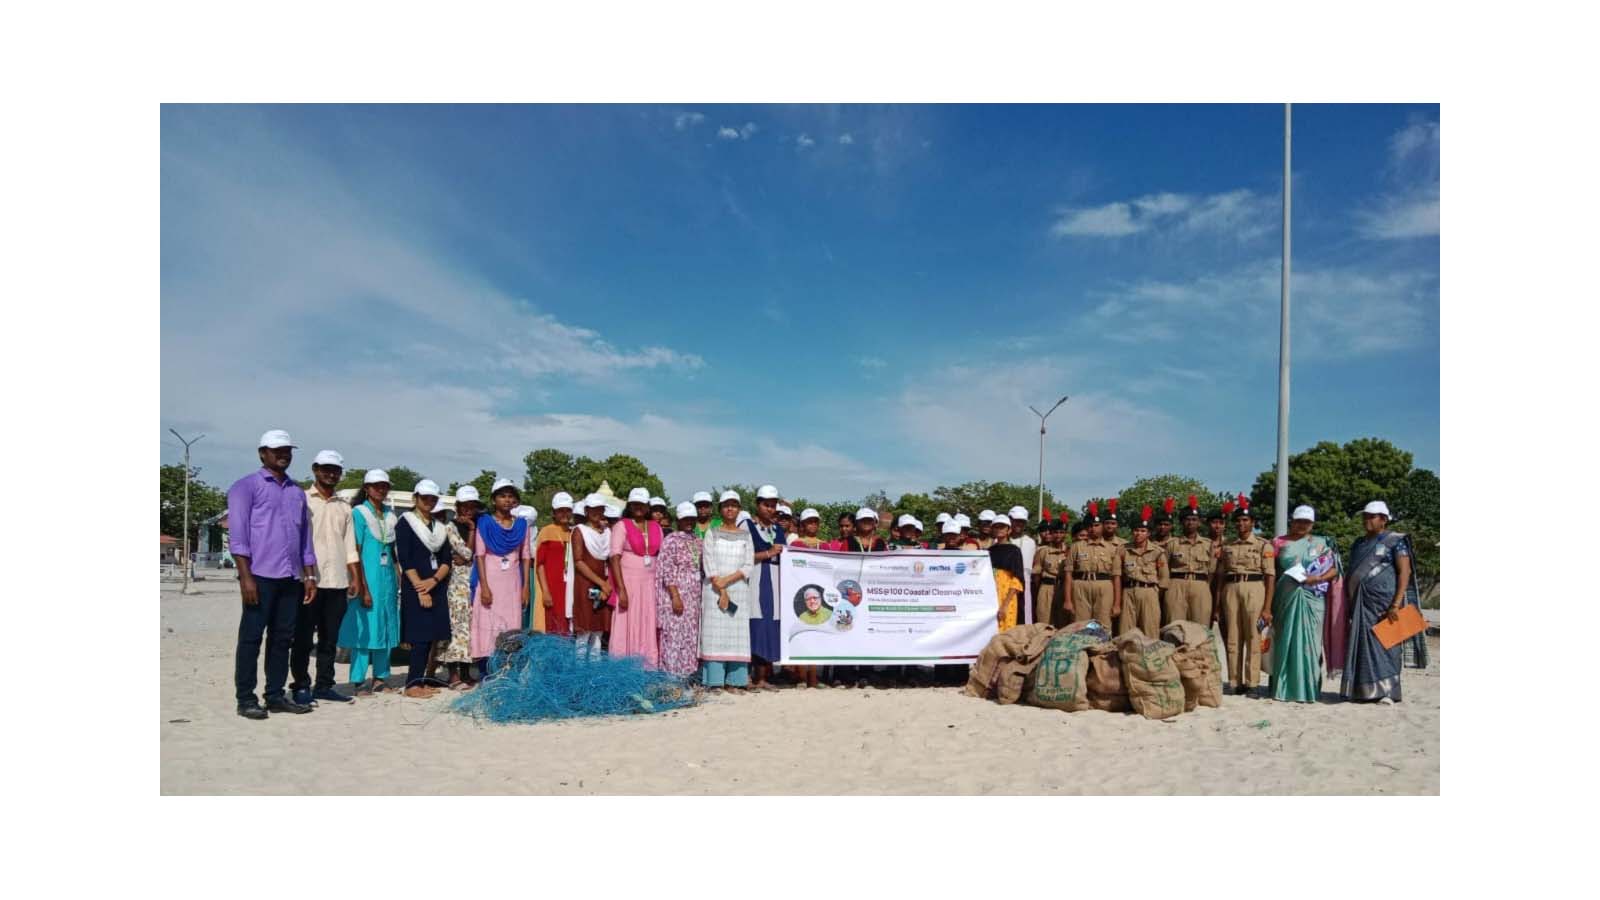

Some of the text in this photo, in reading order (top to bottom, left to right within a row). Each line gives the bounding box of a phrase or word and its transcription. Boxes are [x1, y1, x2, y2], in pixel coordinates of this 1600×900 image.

[867, 588, 903, 596] MSS@100
[903, 588, 931, 596] Coastal
[932, 588, 961, 597] Cleanup
